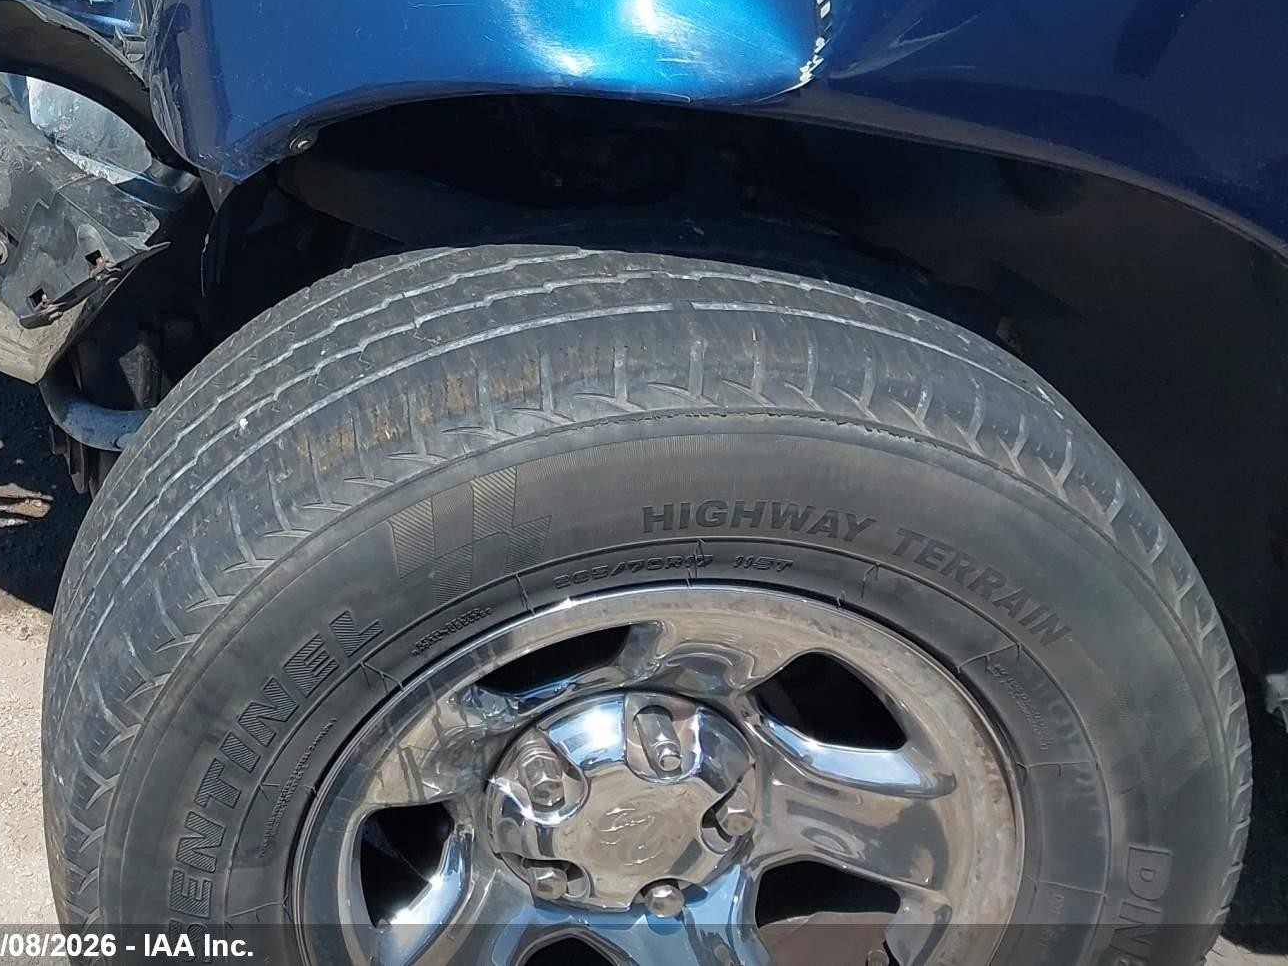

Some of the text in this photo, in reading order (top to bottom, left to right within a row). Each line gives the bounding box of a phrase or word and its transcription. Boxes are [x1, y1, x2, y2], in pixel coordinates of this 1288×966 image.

[641, 499, 1073, 646] HIGHWAY TERRAIN
[733, 554, 794, 573] 115T
[168, 609, 384, 963] SENTINEL
